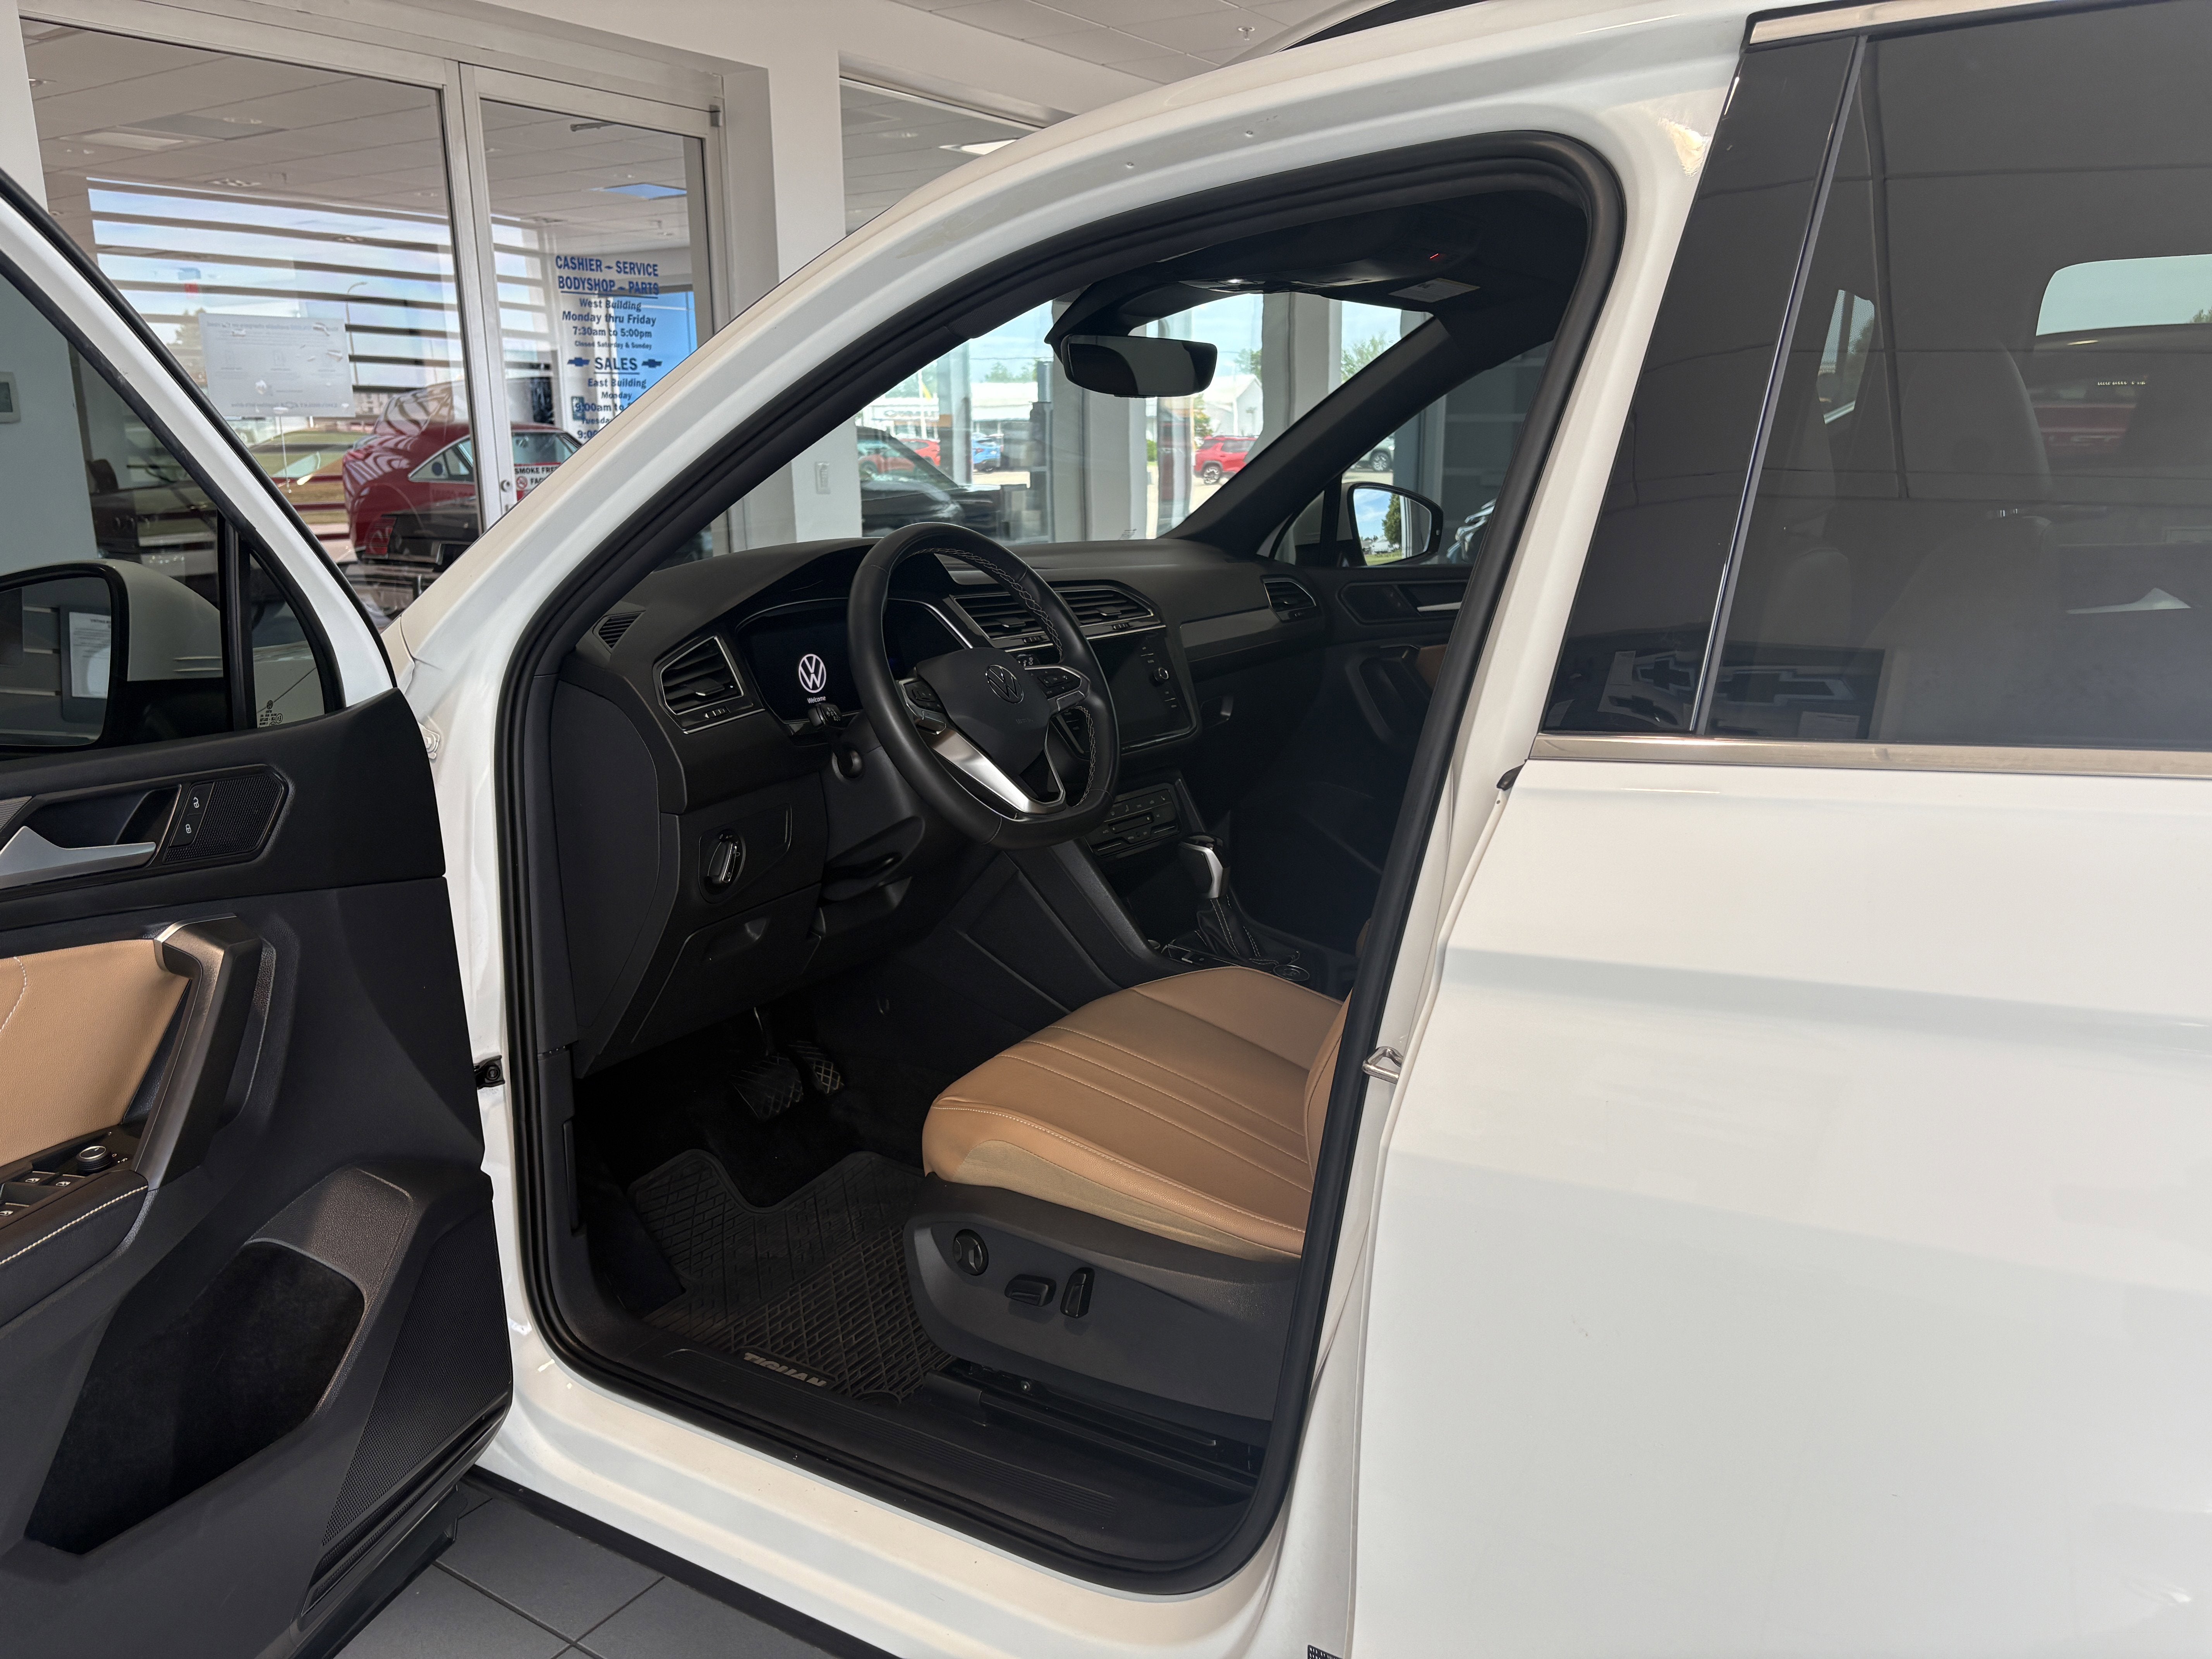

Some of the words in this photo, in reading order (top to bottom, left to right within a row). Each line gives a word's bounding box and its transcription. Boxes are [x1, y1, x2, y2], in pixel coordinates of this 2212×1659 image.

[555, 255, 603, 272] CASHIER
[616, 260, 658, 277] SERVICE
[558, 275, 615, 292] BODYSHOP
[628, 281, 659, 295] PARTS
[579, 298, 602, 308] West
[605, 300, 642, 312] Building
[562, 311, 602, 324] Monday
[605, 313, 624, 323] thru
[627, 314, 657, 327] Friday
[573, 326, 606, 336] 7:30am
[609, 328, 618, 337] to
[620, 328, 652, 339] 5:00pm
[632, 342, 652, 350] Sunday
[595, 357, 638, 370] SALES
[588, 378, 608, 387] East
[611, 378, 647, 389] Building
[601, 391, 632, 400] Monday
[581, 416, 611, 424] Tuesda
[807, 696, 826, 704] Welcome
[743, 1352, 827, 1387] TIGUAN
